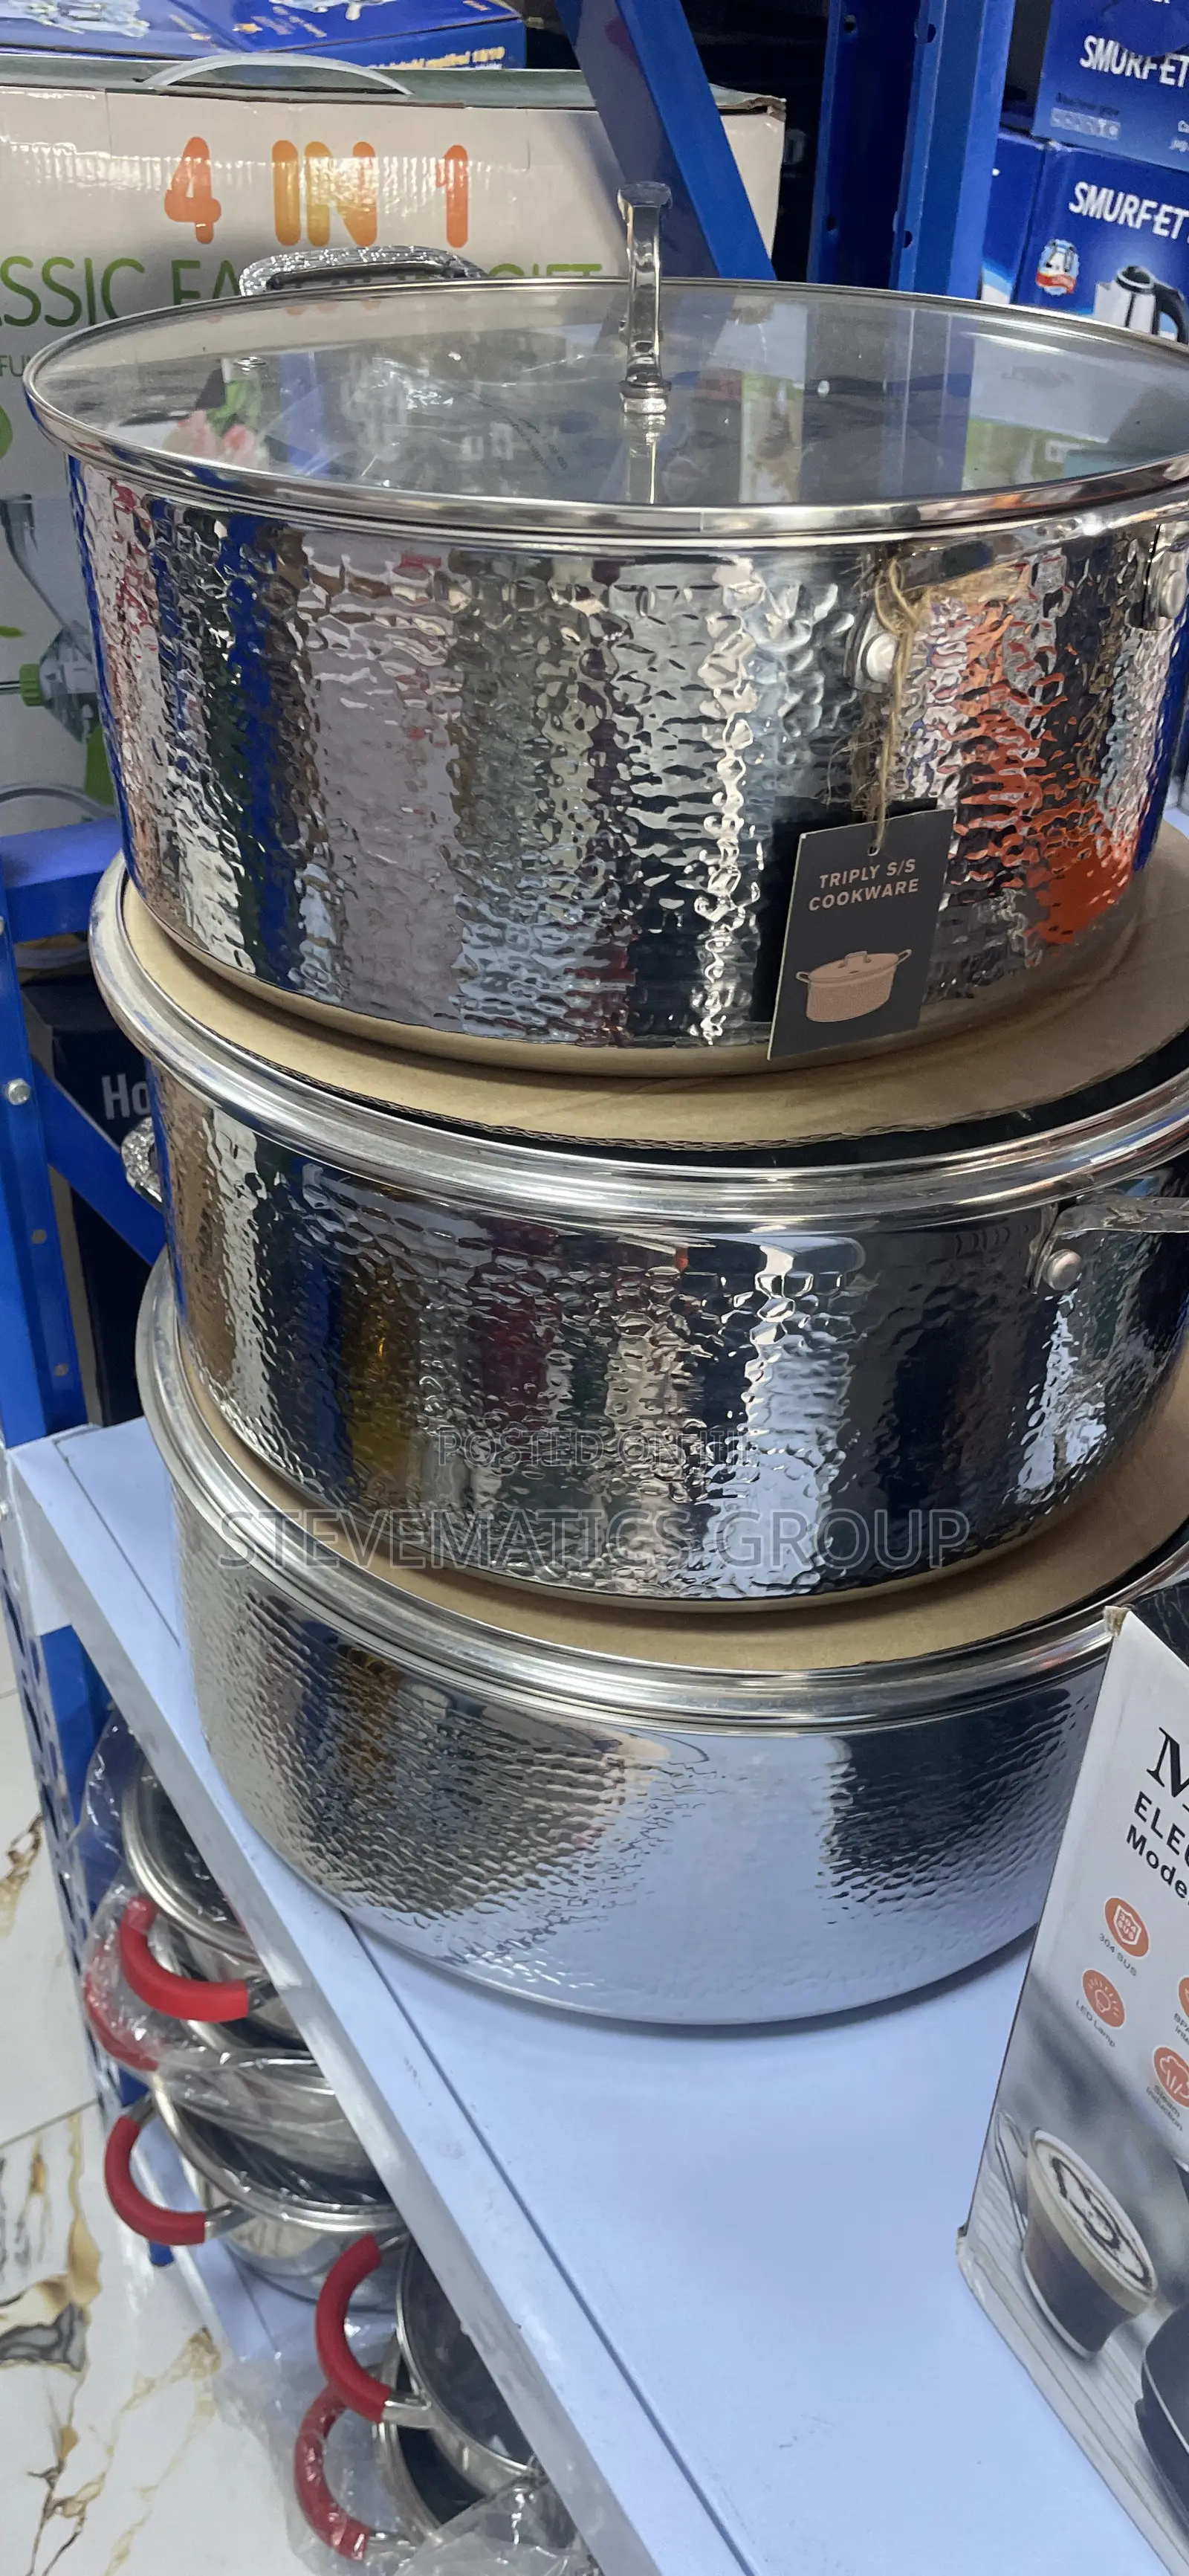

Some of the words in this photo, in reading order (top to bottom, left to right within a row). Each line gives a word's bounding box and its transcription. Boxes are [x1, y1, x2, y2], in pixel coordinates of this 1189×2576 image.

[164, 137, 221, 244] 4
[272, 140, 378, 247] IN
[435, 145, 468, 248] 1
[1069, 181, 1189, 243] SMURFET
[0, 256, 145, 327] SSIC
[809, 878, 919, 911] COOKWARE
[819, 864, 881, 888] TRIPLY
[886, 858, 916, 877] S/S
[1127, 1824, 1189, 1905] Mode
